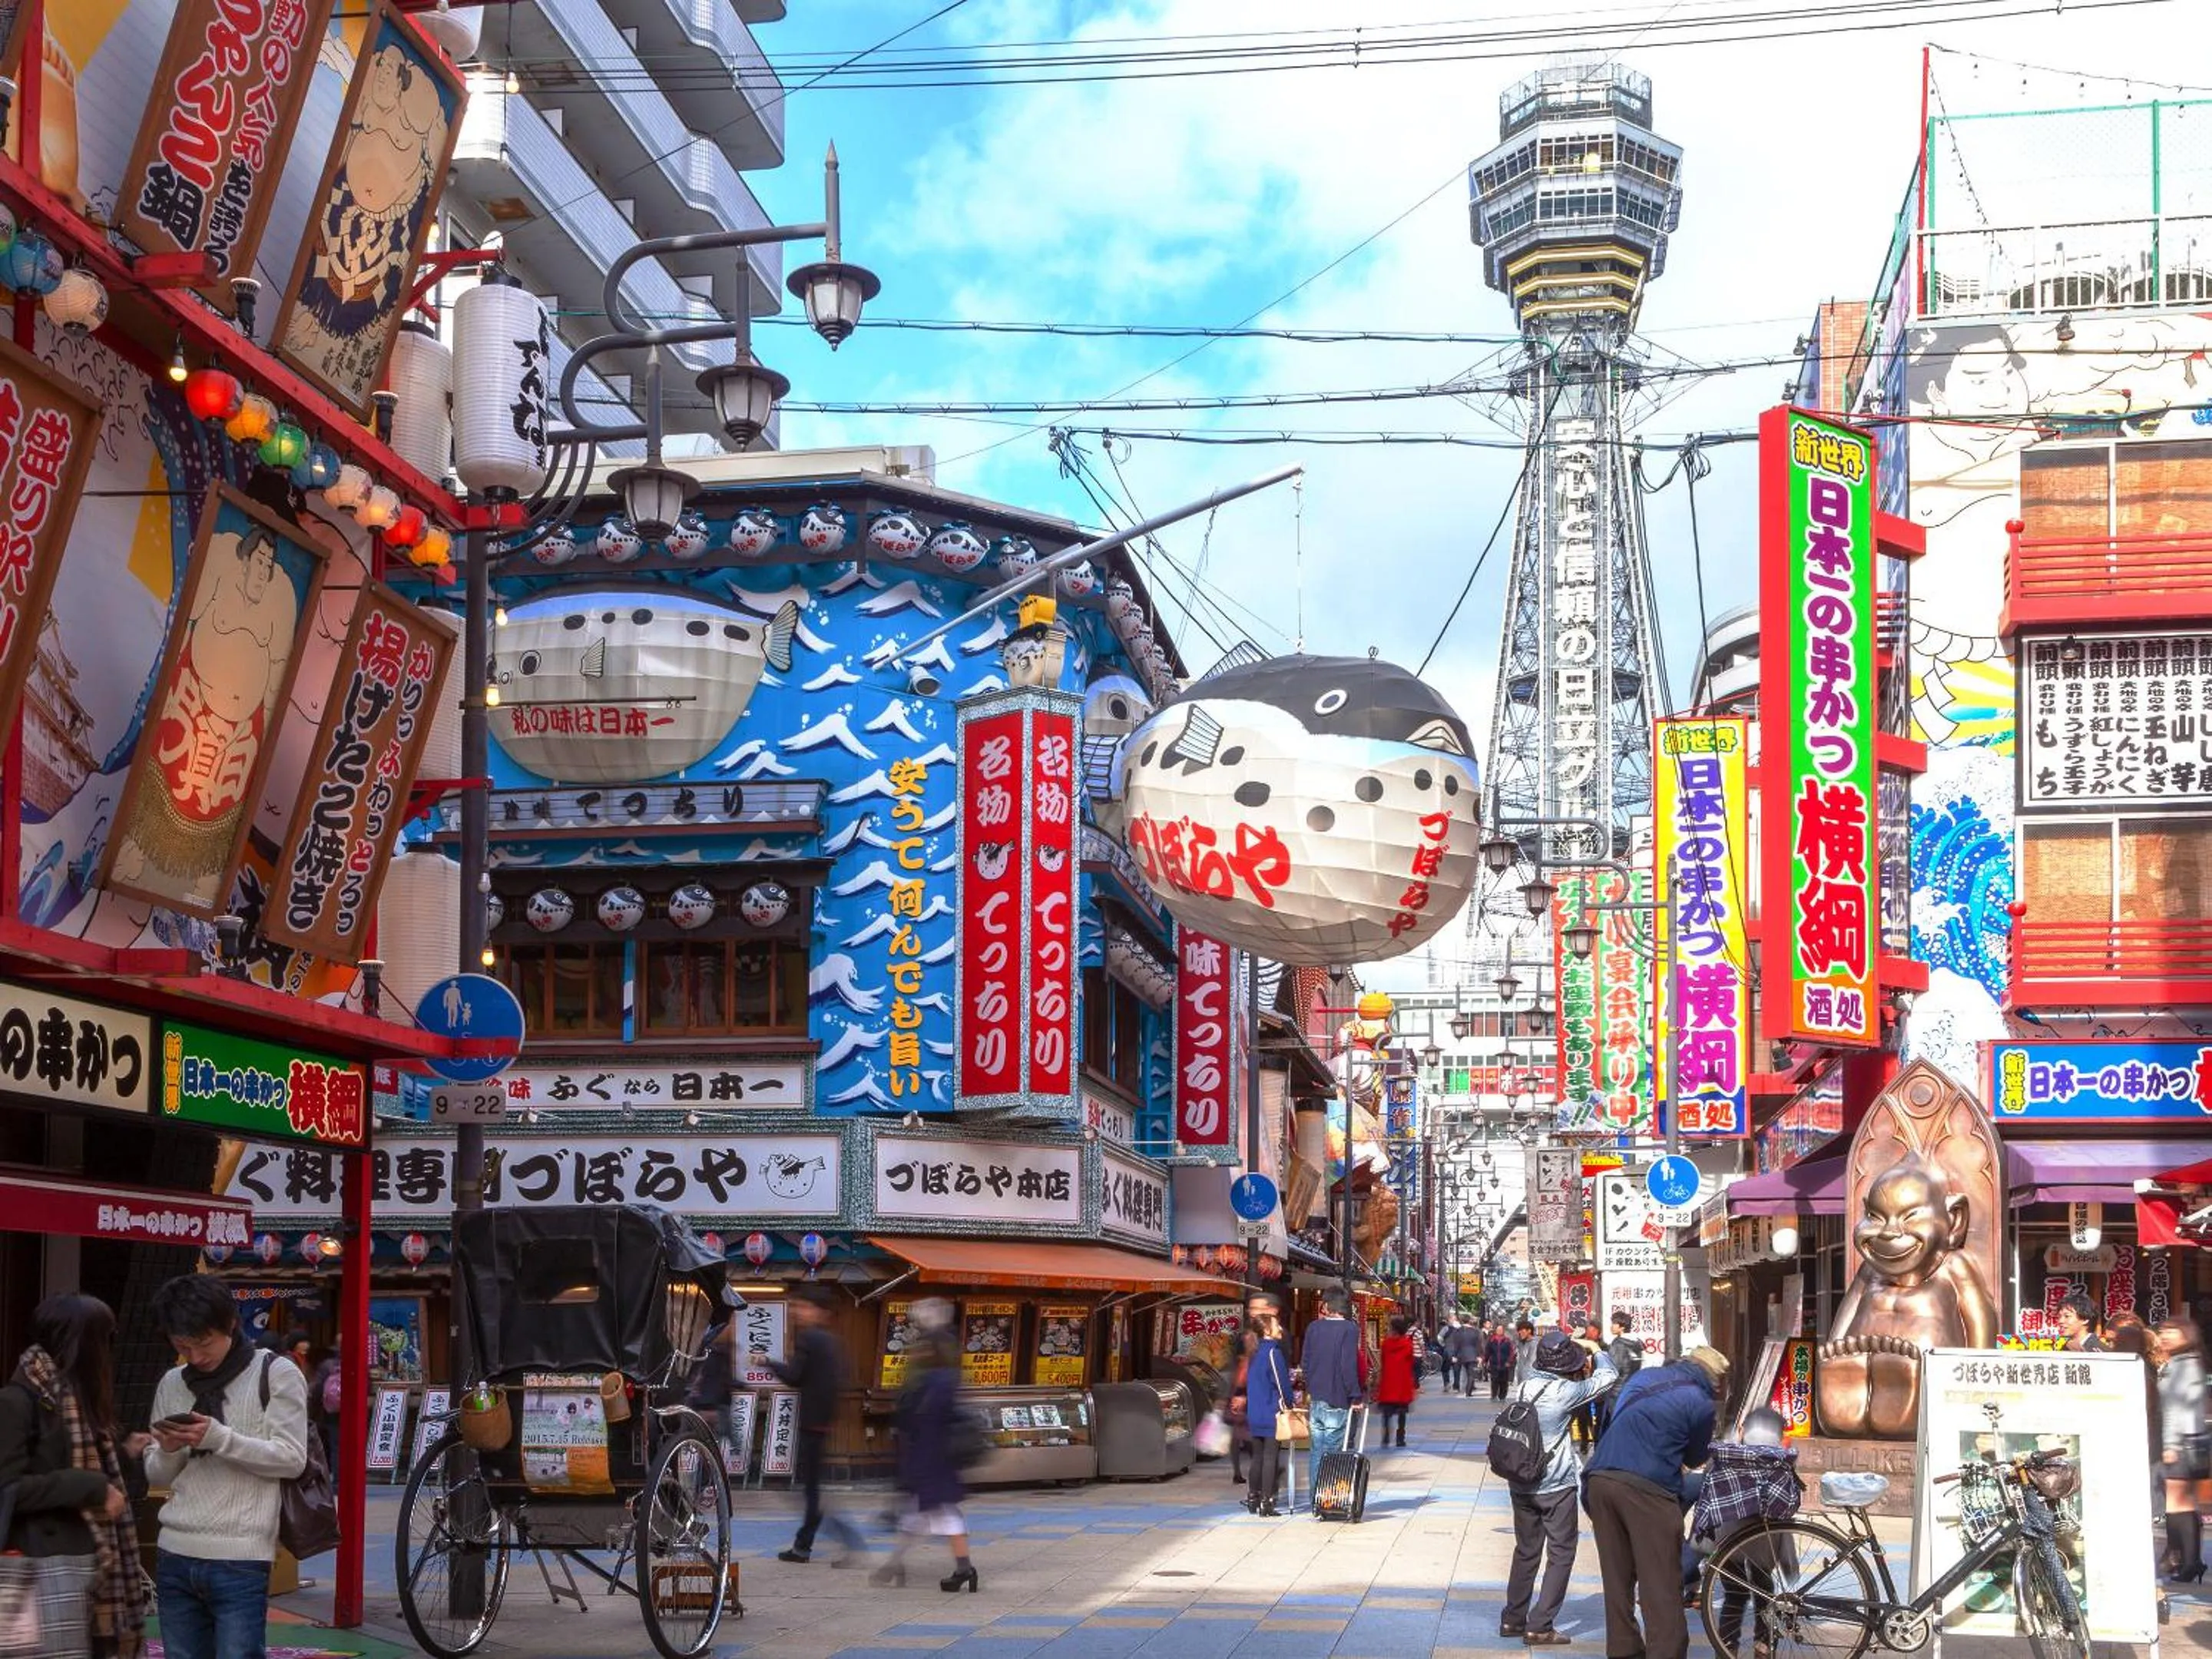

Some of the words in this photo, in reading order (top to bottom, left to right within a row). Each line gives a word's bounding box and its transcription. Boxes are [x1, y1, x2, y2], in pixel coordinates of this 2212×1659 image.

[1793, 426, 1864, 481] 新世界
[1806, 478, 1856, 773] 日本一の串かつ
[512, 707, 675, 736] 私の味は日本一
[1664, 727, 1739, 753] 新世界
[2062, 717, 2088, 796] うずら玉子
[2089, 717, 2114, 795] 紅しょうが
[2116, 716, 2141, 794] にんにく
[2144, 715, 2170, 793] 玉ねぎ
[2171, 714, 2196, 792] 山芋
[1129, 811, 1291, 909] づぼらや
[1387, 810, 1453, 939] づぼらや
[1677, 758, 1727, 958] 日本一の串かつ
[1797, 777, 1866, 979] 横綱
[1805, 985, 1866, 1029] 酒処
[0, 1008, 143, 1099] の串かつ
[2029, 1063, 2192, 1100] 日本一の串かつ
[287, 1060, 364, 1141] 横綱
[886, 1162, 1071, 1201] づぼらや本店
[1181, 1308, 1239, 1337] 串かつ
[1952, 1363, 2059, 1386] づぼらや新世界店
